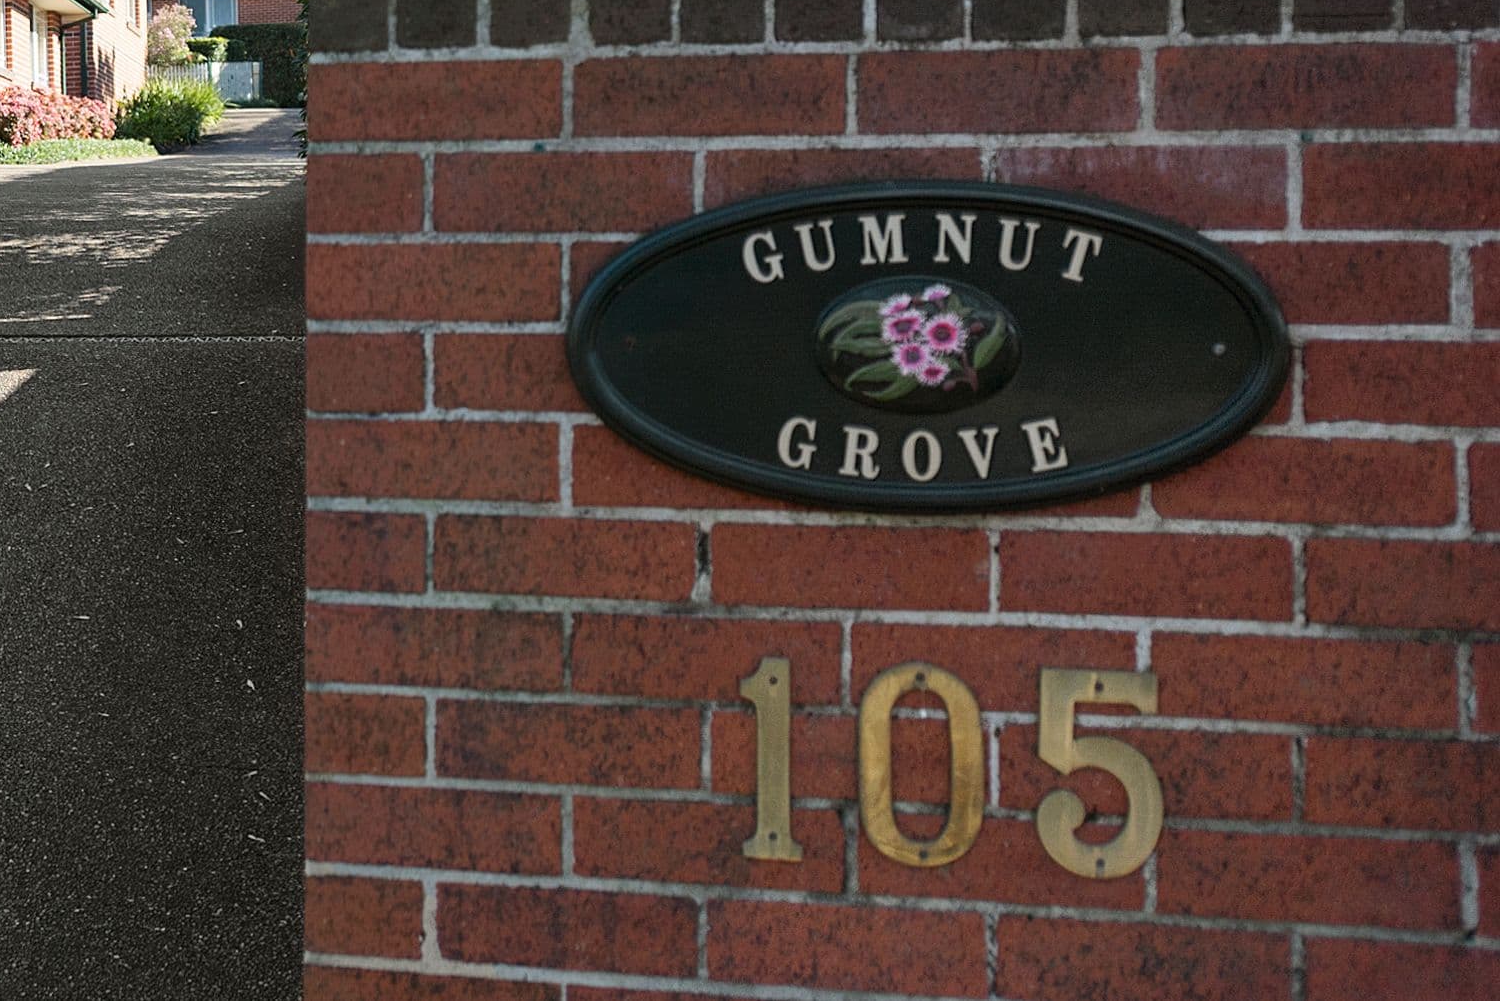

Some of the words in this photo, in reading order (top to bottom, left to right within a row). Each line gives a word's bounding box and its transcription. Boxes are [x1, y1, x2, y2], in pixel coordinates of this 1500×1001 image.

[742, 213, 1103, 284] GUMNUT
[777, 417, 1069, 482] GROVE
[739, 656, 1165, 880] 105
